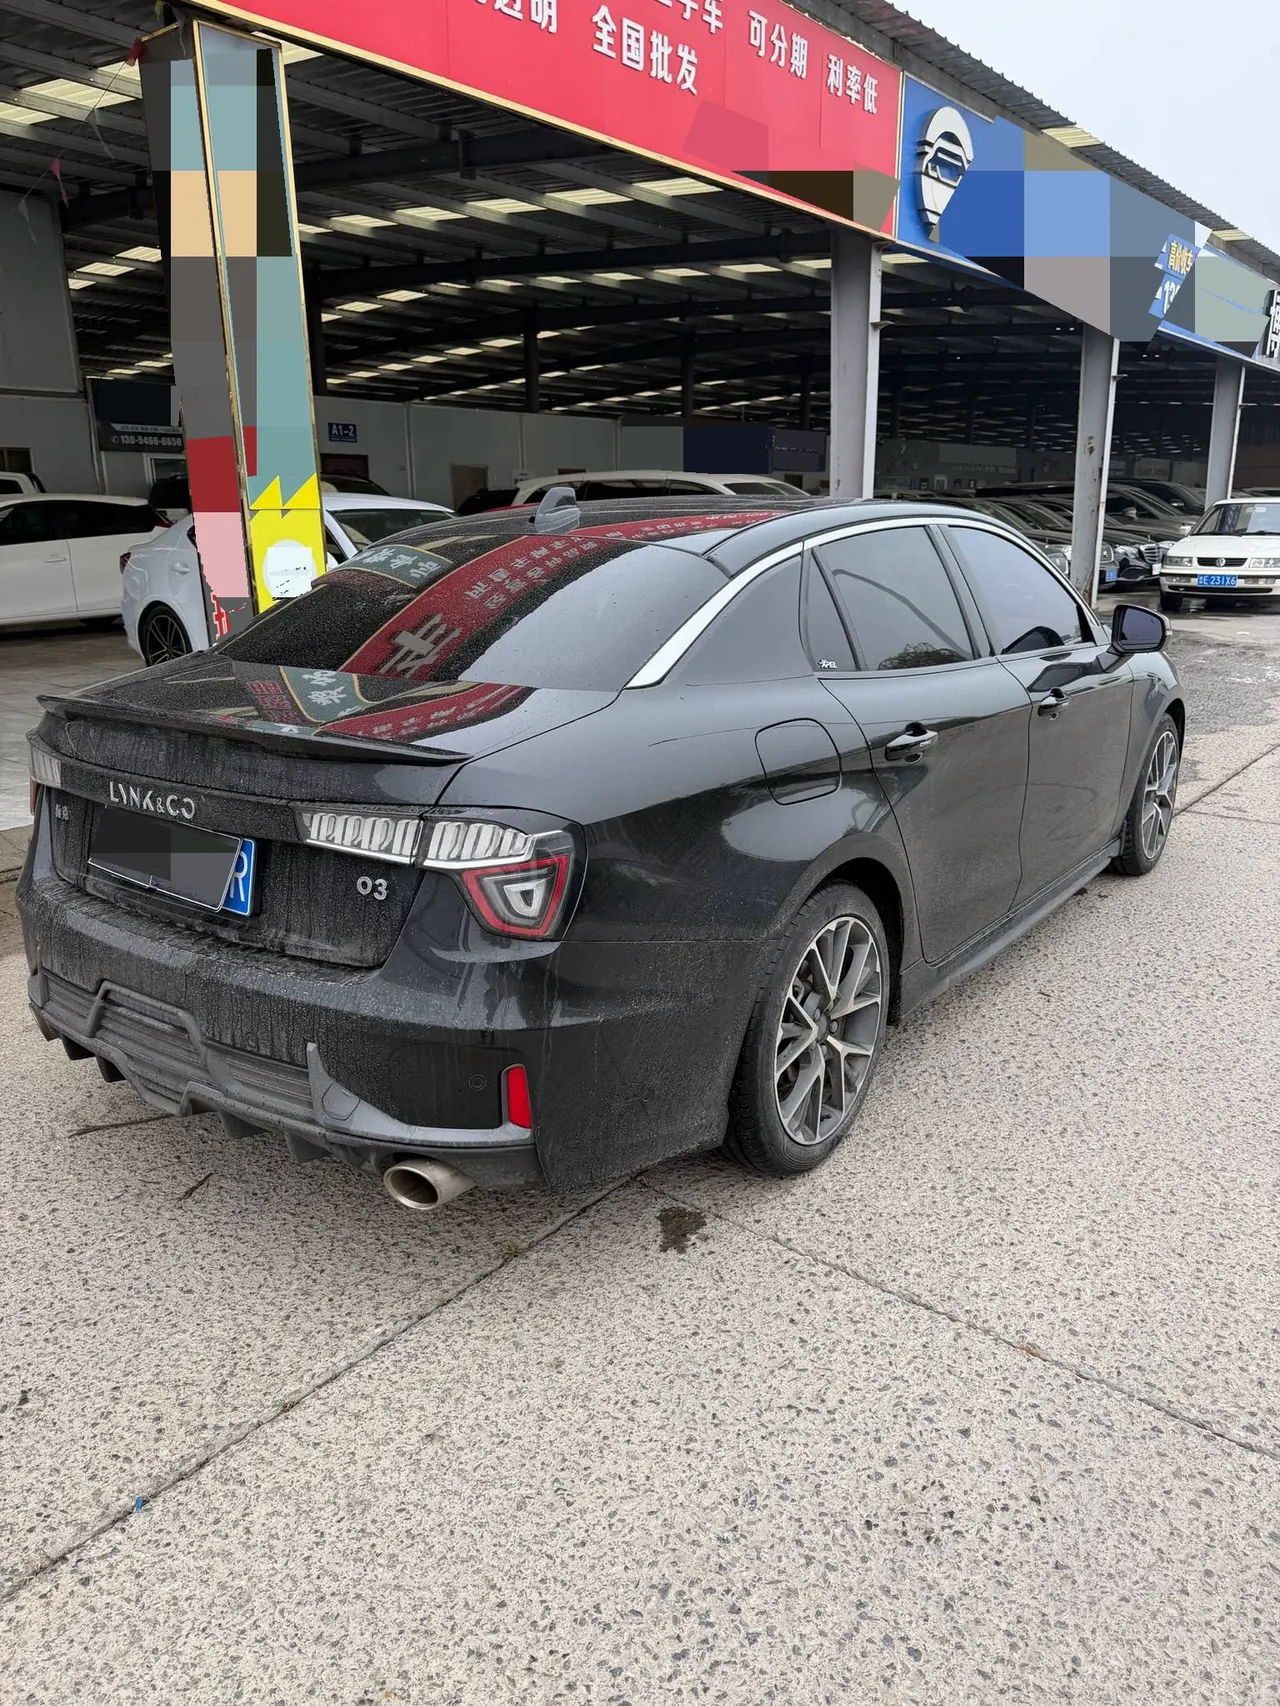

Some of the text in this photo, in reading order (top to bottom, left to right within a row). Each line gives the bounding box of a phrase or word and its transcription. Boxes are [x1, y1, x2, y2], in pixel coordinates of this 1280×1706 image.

[591, 5, 698, 96] 全国批发
[748, 9, 808, 79] 可分期
[827, 53, 878, 115] 利率低
[332, 424, 355, 437] A1-2
[109, 781, 196, 820] LYNK&CO
[356, 875, 388, 901] 03
